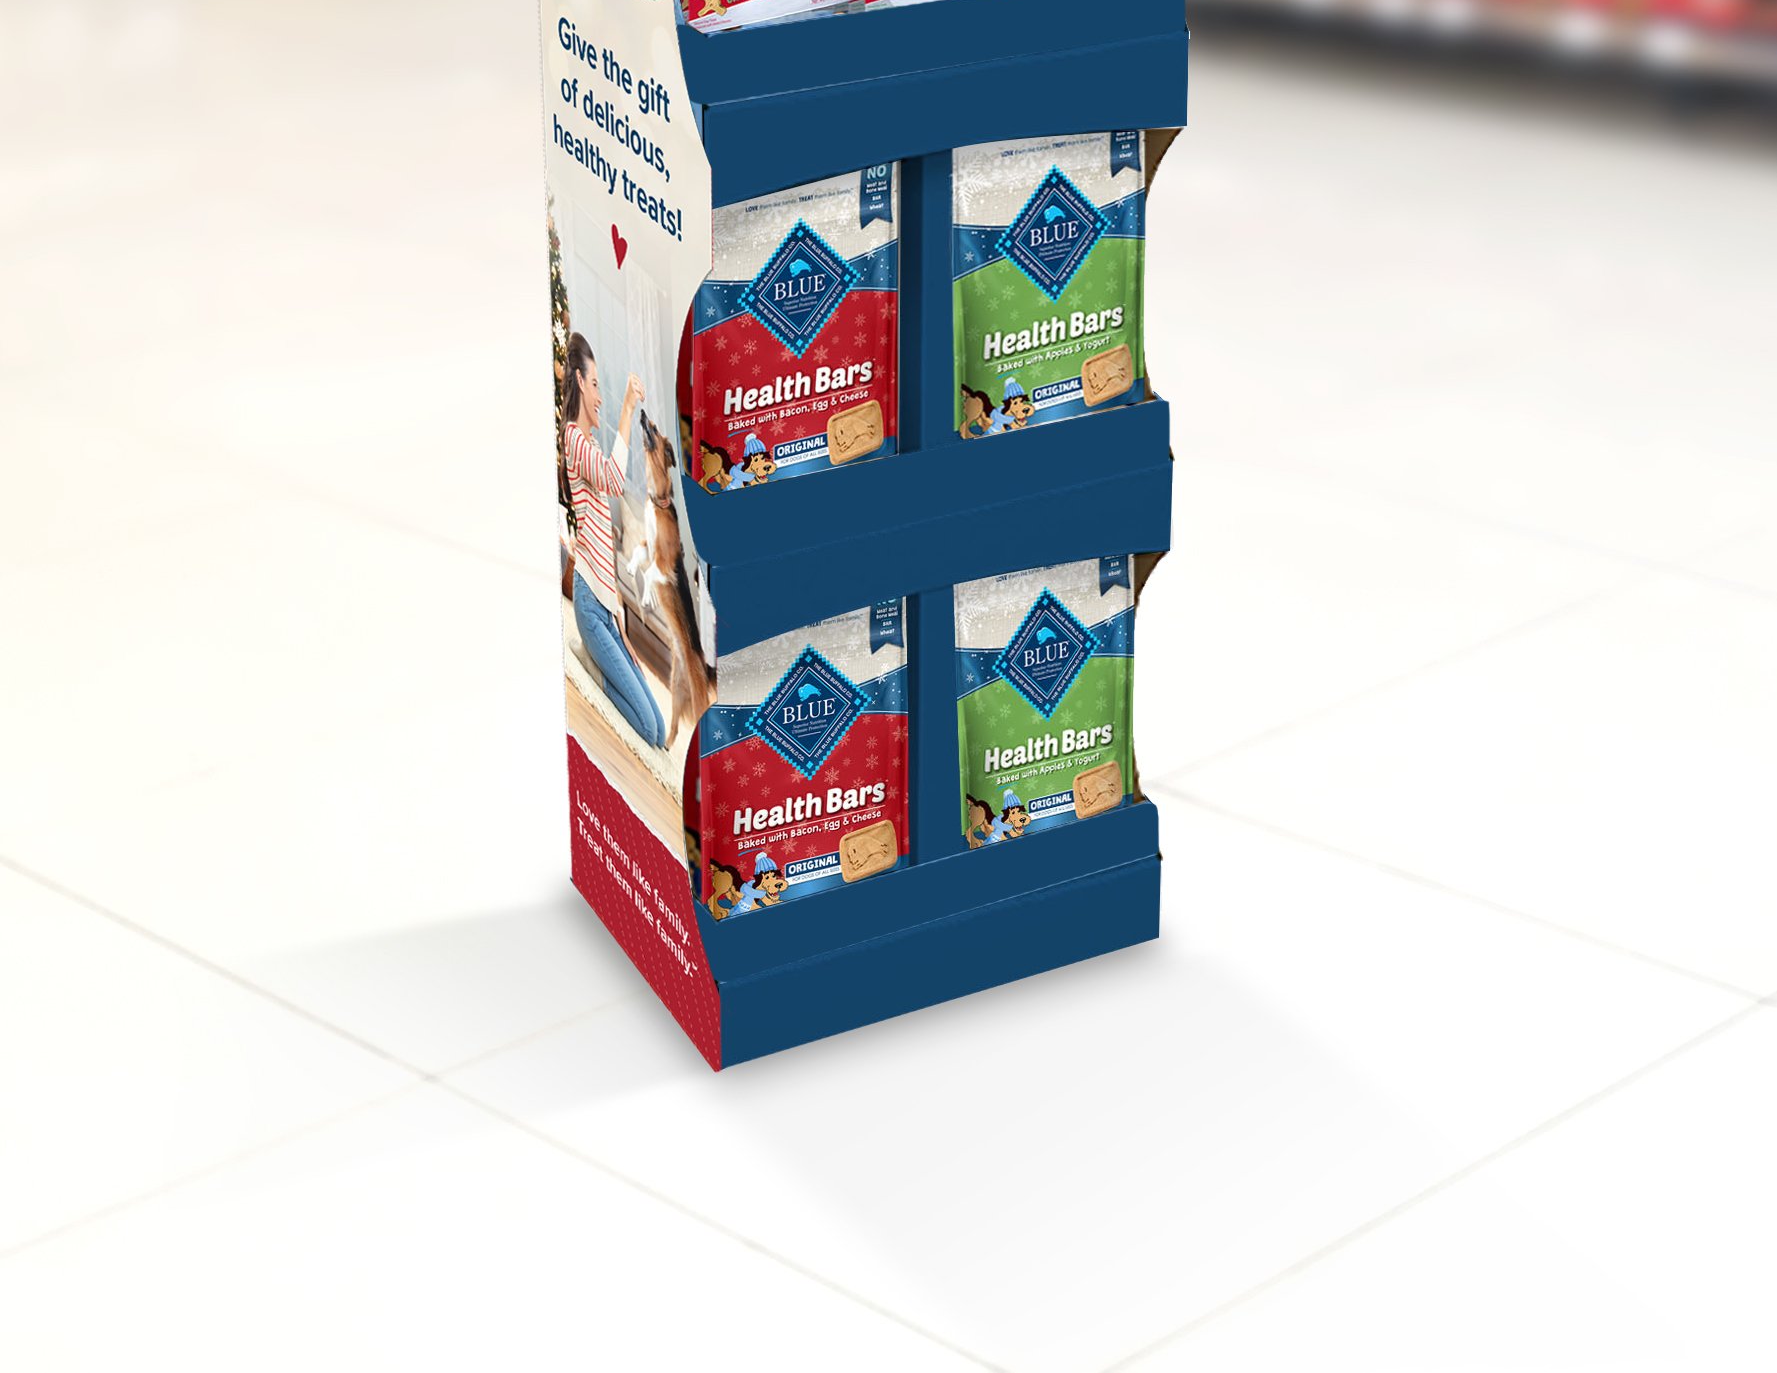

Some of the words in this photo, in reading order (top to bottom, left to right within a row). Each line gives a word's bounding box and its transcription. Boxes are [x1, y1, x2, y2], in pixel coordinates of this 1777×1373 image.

[558, 17, 597, 70] Give
[602, 48, 632, 95] the
[638, 77, 670, 123] gift
[561, 78, 578, 108] of
[583, 89, 670, 183] delicious,
[553, 113, 617, 194] healthy
[622, 170, 682, 242] treats!
[867, 165, 887, 179] NO
[745, 205, 759, 213] LOVE
[798, 194, 814, 203] TREAT
[1030, 220, 1080, 247] BLUE
[773, 274, 827, 302] BLUE
[983, 316, 1066, 361] Health
[1069, 306, 1124, 338] Bars
[996, 360, 1024, 374] Baked
[1025, 354, 1044, 366] with
[1044, 348, 1074, 361] Apples
[1075, 344, 1082, 352] &
[1084, 336, 1111, 351] Yogurt
[723, 371, 810, 416] Health
[815, 360, 874, 393] Bars
[1034, 380, 1081, 400] ORIGINAL
[727, 417, 756, 432] Baked
[758, 413, 778, 424] with
[779, 406, 810, 419] Bacon,
[812, 402, 829, 412] Egg
[831, 397, 838, 406] &
[839, 390, 869, 403] Cheese
[777, 436, 826, 456] ORIGINAL
[1023, 640, 1070, 668] BLUE
[782, 698, 836, 725] BLUE
[984, 733, 1059, 774] Health
[1062, 723, 1113, 754] Bars
[1021, 770, 1039, 780] with
[1040, 763, 1066, 775] Apples
[1067, 760, 1073, 768] &
[1075, 752, 1101, 765] Yogurt
[733, 793, 823, 836] Health
[826, 782, 886, 814] Bars
[1030, 793, 1072, 811] ORIGINAL
[738, 836, 766, 850] Baked
[768, 832, 788, 843] with
[790, 826, 823, 838] Bacon,
[824, 820, 841, 832] Egg
[842, 817, 850, 826] &
[852, 810, 882, 824] Cheese
[576, 790, 600, 831] Love
[602, 825, 630, 869] them
[632, 863, 652, 895] like
[654, 888, 691, 947] family.
[576, 816, 604, 863] Treat
[606, 856, 632, 900] them
[634, 890, 654, 927] like
[788, 854, 838, 875] ORIGINAL
